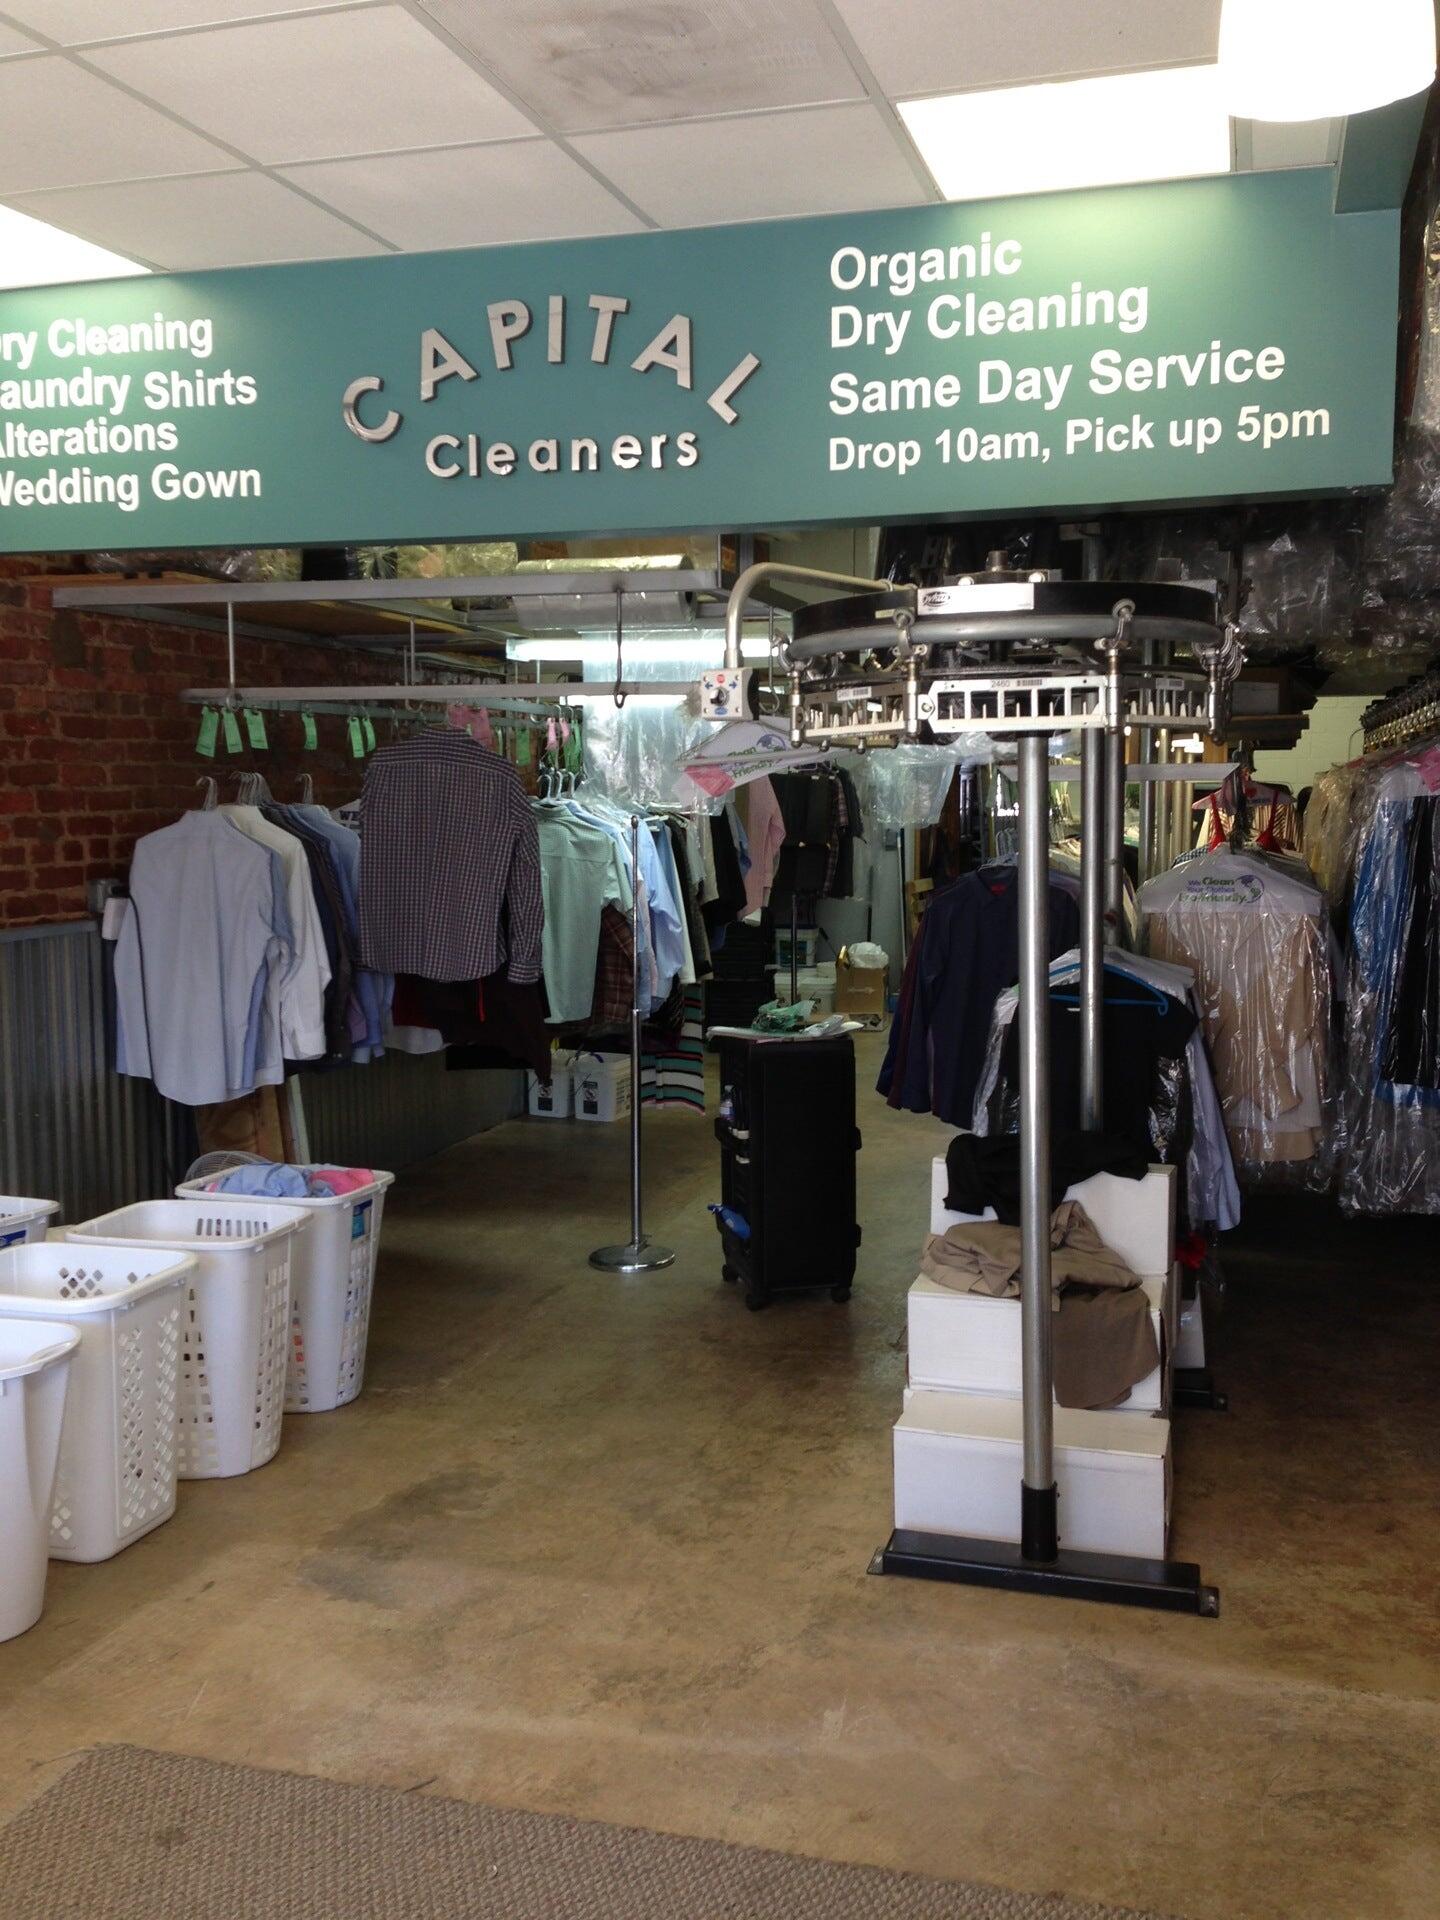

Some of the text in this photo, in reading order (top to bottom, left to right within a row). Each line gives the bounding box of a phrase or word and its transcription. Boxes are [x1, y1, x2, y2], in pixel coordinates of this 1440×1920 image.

[831, 232, 1023, 296] Organic
[0, 312, 214, 370] ry Cleaning
[831, 281, 1149, 355] Dry Cleaning
[0, 366, 258, 416] aundry Shirts
[342, 294, 761, 443] CAPITAL
[829, 340, 1286, 415] Same Day Service
[425, 431, 700, 478] Cleaners
[829, 405, 1330, 475] Drop 10am, Pick up 5pm
[151, 462, 261, 501] Gown
[1202, 877, 1234, 886] Clean
